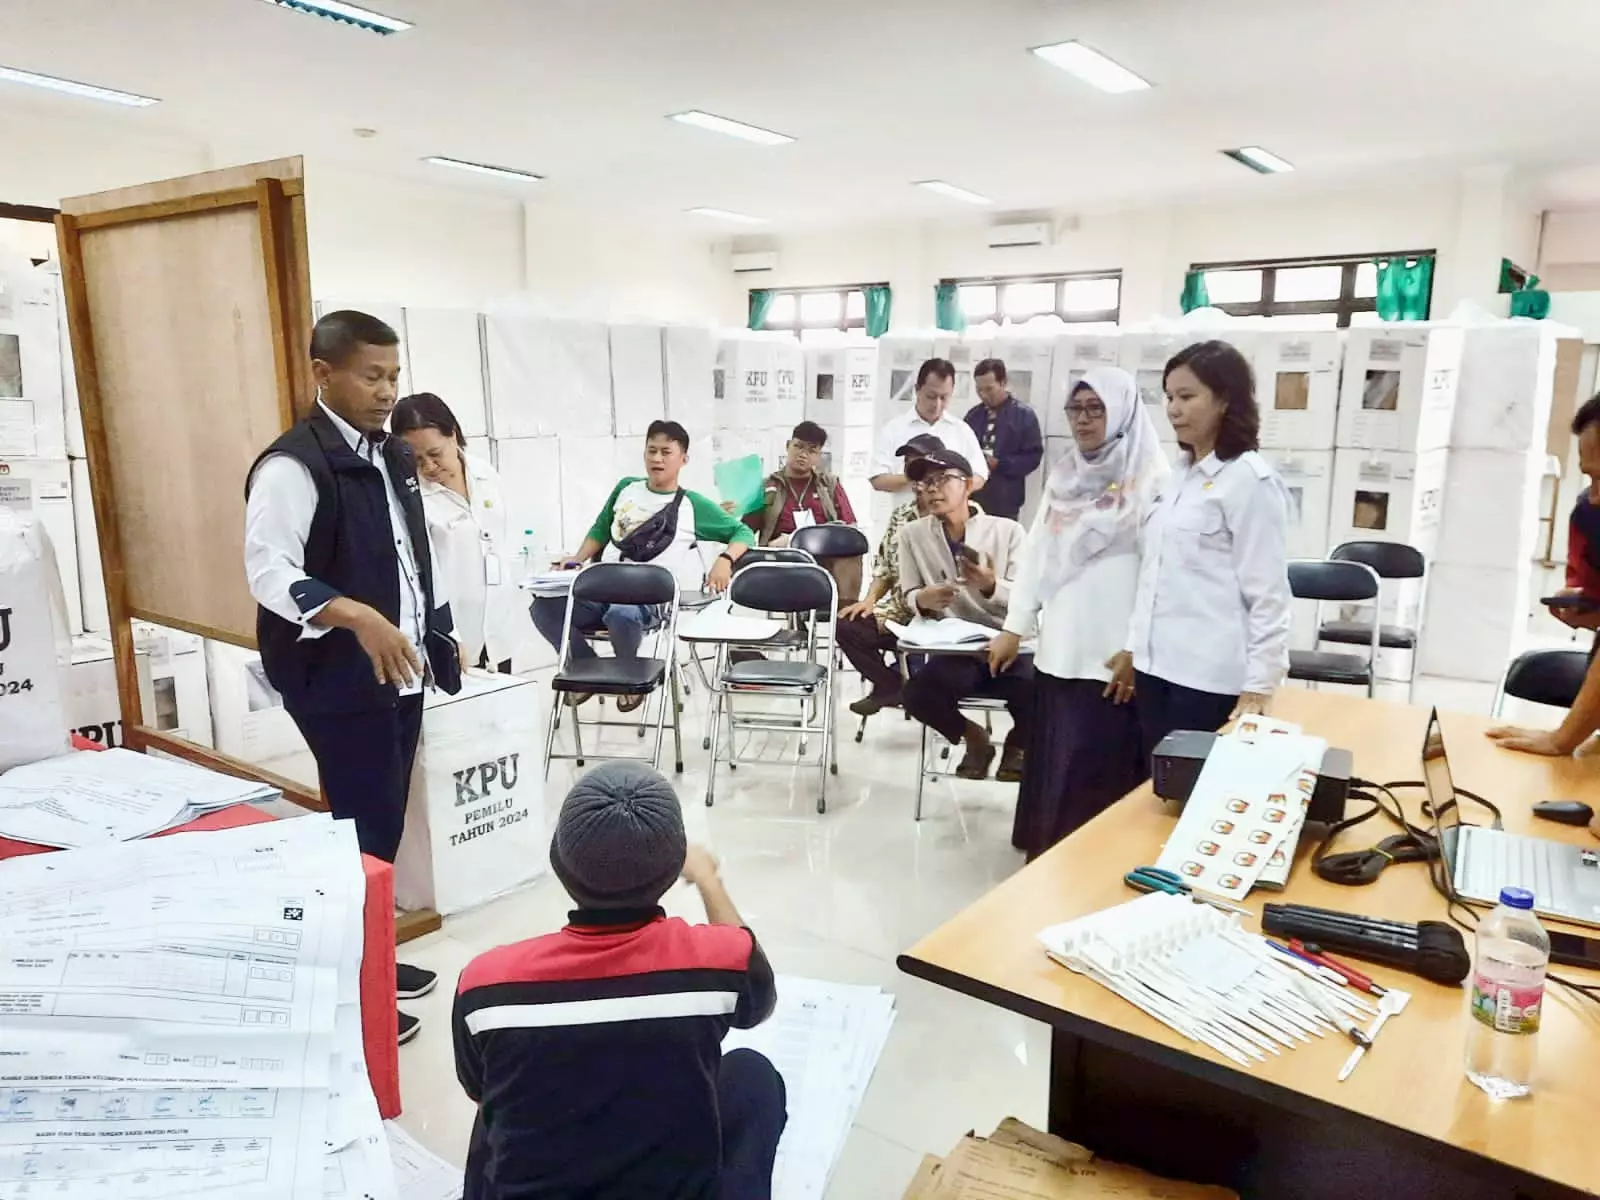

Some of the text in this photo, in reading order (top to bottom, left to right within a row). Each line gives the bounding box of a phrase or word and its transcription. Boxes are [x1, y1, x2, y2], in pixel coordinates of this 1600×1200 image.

[0, 678, 34, 697] 024
[453, 753, 519, 807] KPU
[450, 808, 529, 845] TAHUN 2024
[464, 798, 512, 824] PEMILU
